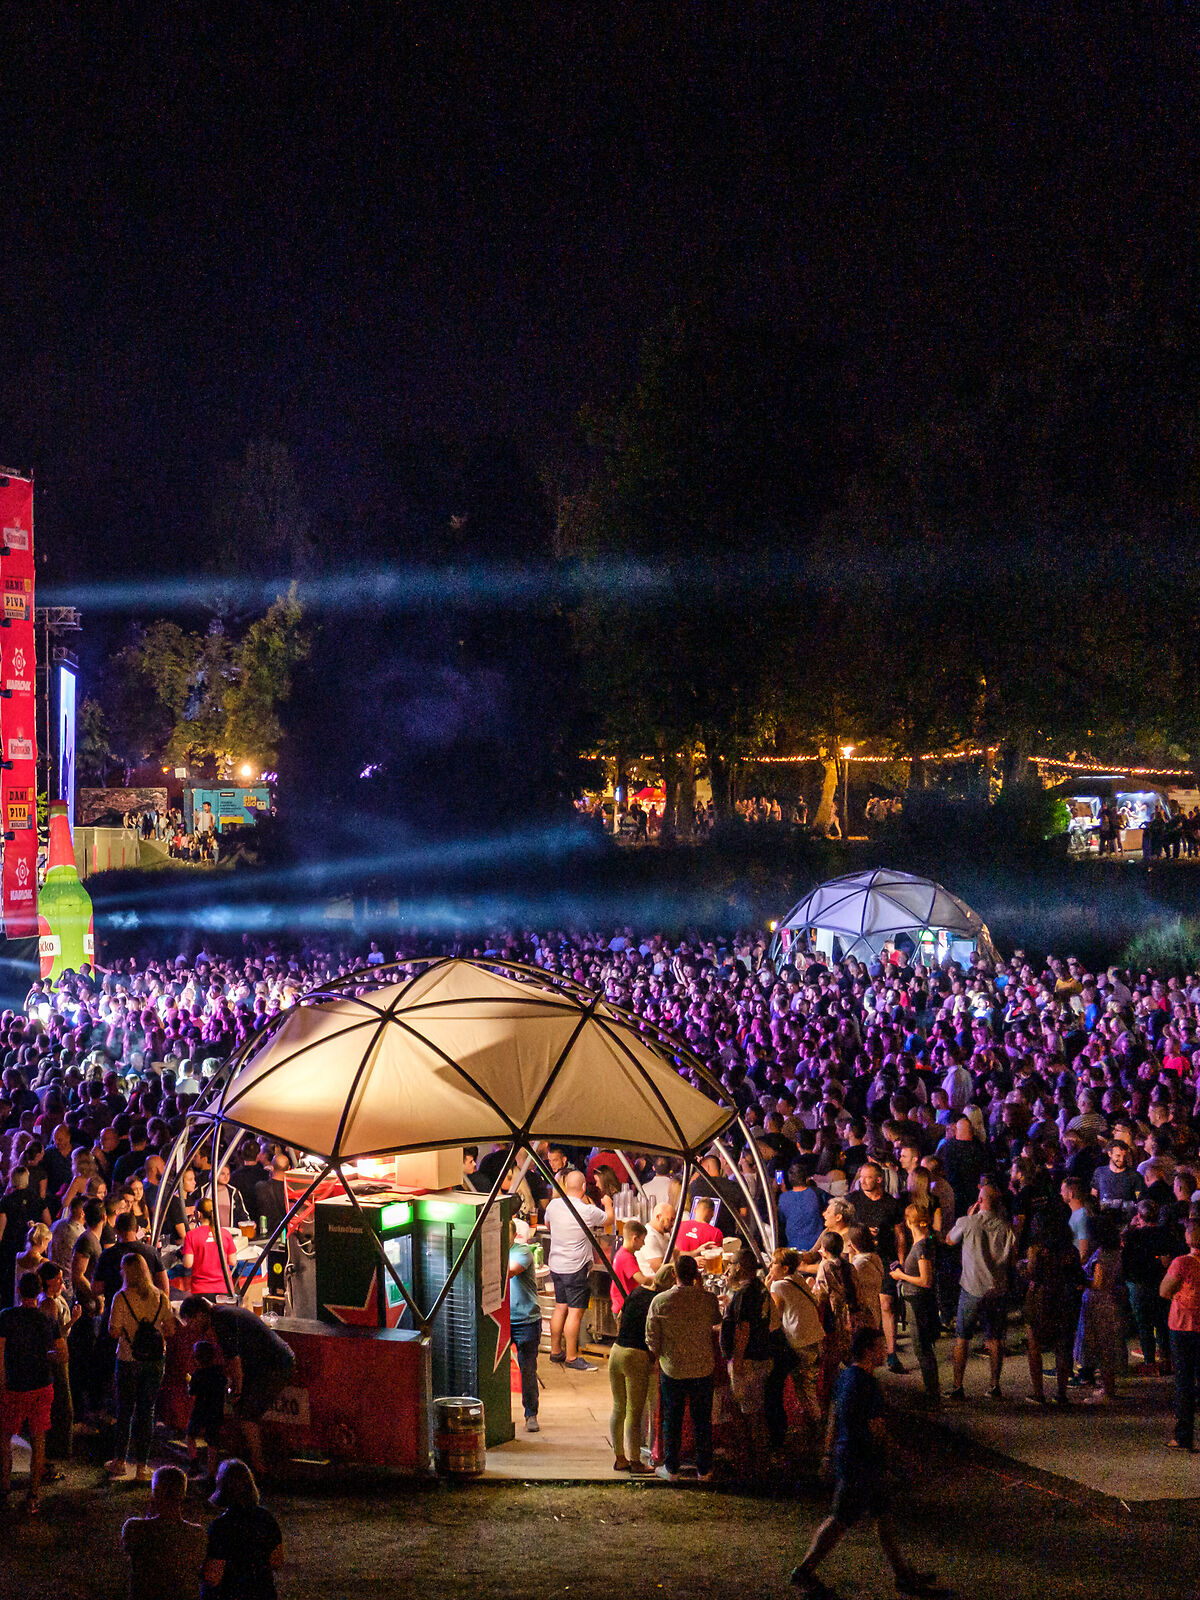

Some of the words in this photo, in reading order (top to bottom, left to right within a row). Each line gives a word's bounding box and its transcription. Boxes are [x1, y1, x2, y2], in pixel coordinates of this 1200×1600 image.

[6, 596, 24, 607] PIVA
[9, 791, 27, 801] DANI
[10, 807, 27, 817] PIVA
